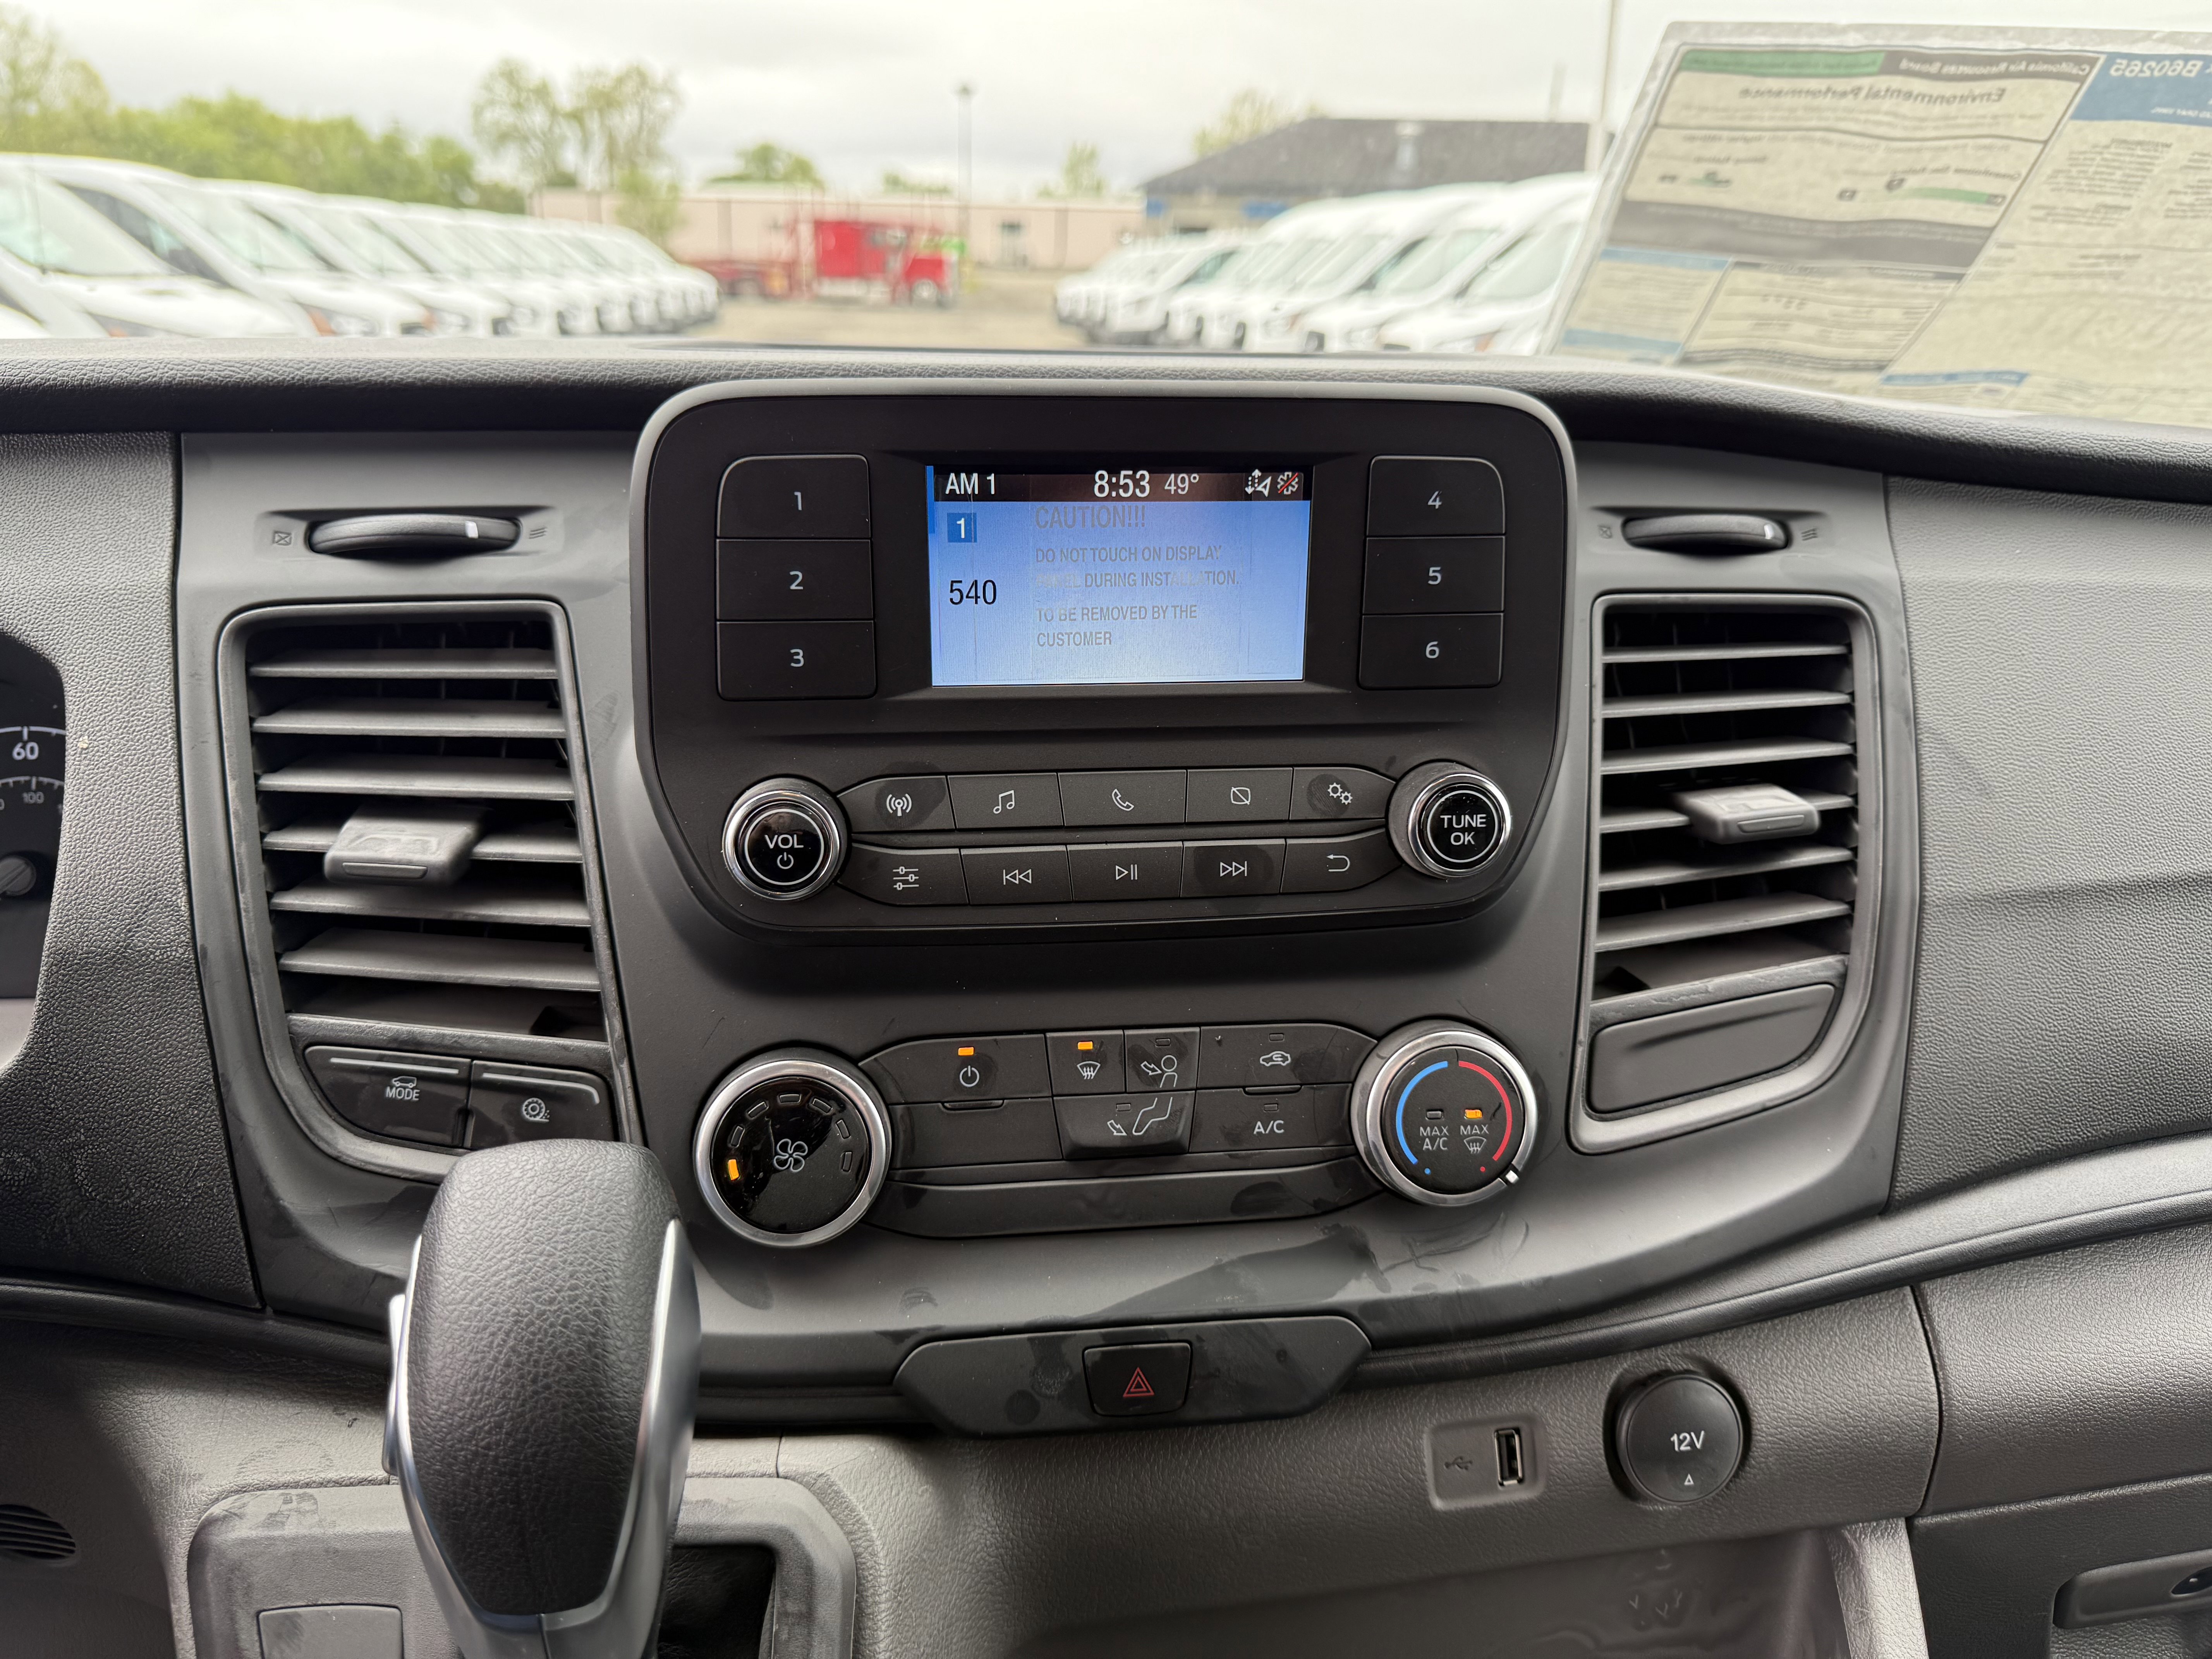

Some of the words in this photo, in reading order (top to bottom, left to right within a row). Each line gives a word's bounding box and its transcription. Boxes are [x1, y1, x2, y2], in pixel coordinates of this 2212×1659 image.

[945, 473, 978, 495] AM
[986, 473, 995, 495] 1
[1094, 470, 1150, 498] 8:53
[1164, 473, 1199, 495] 49°
[794, 491, 802, 511] 1
[1427, 490, 1442, 509] 4
[1035, 505, 1146, 529] CAUTION!!!
[956, 517, 965, 539] 1
[1036, 548, 1056, 563] DO
[1060, 547, 1088, 563] NOT
[1089, 546, 1138, 563] TOUCH
[1141, 546, 1162, 562] ON
[1165, 545, 1222, 562] DISPLAY
[790, 571, 804, 590] 2
[1085, 572, 1137, 588] DURING
[1428, 567, 1442, 585] 5
[950, 580, 997, 605] 540
[1036, 607, 1054, 623] TO
[1058, 606, 1077, 622] BE
[1081, 605, 1148, 622] REMOVED
[1152, 605, 1169, 620] BY
[1171, 604, 1198, 620] THE
[1037, 631, 1112, 647] CUSTOMER
[790, 649, 804, 667] 3
[1425, 641, 1439, 659] 6
[12, 742, 39, 760] 60
[22, 792, 45, 804] 100
[1440, 814, 1487, 829] TUNE
[765, 834, 804, 849] VOL
[1450, 832, 1475, 846] OK
[385, 1086, 420, 1101] MODE
[1253, 1120, 1284, 1135] A/C
[1420, 1125, 1449, 1136] MAX
[1460, 1124, 1489, 1135] MAX
[1422, 1137, 1448, 1151] A/C
[1670, 1431, 1705, 1452] 12V
